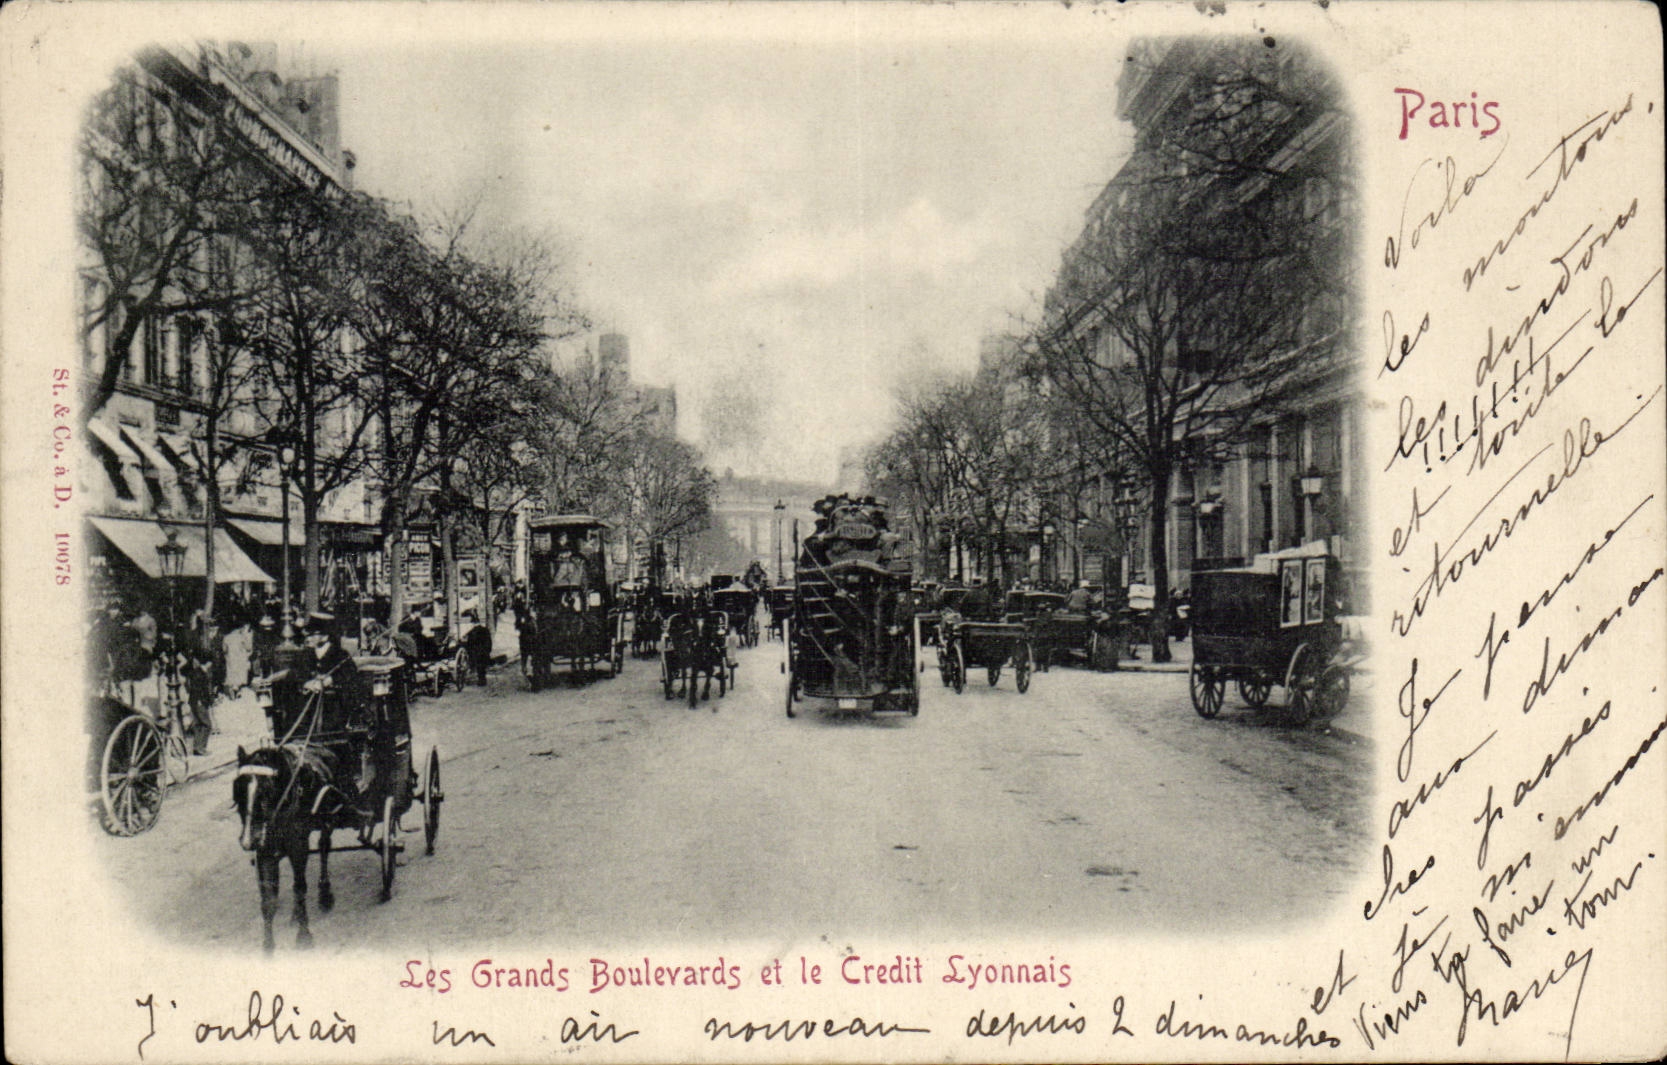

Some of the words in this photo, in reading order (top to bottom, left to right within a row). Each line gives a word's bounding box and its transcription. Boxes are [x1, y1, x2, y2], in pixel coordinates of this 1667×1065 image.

[1377, 309, 1430, 380] les
[1384, 395, 1447, 472] les
[1476, 198, 1639, 388] dindons
[1389, 486, 1452, 557] et
[1572, 826, 1619, 874] un
[1311, 949, 1358, 1016] et
[433, 1020, 495, 1047] un
[561, 1010, 639, 1043] air
[704, 1017, 931, 1043] nouveau
[967, 1002, 1086, 1047] depuis
[1112, 995, 1134, 1037] 2
[1155, 993, 1341, 1049] dimanches
